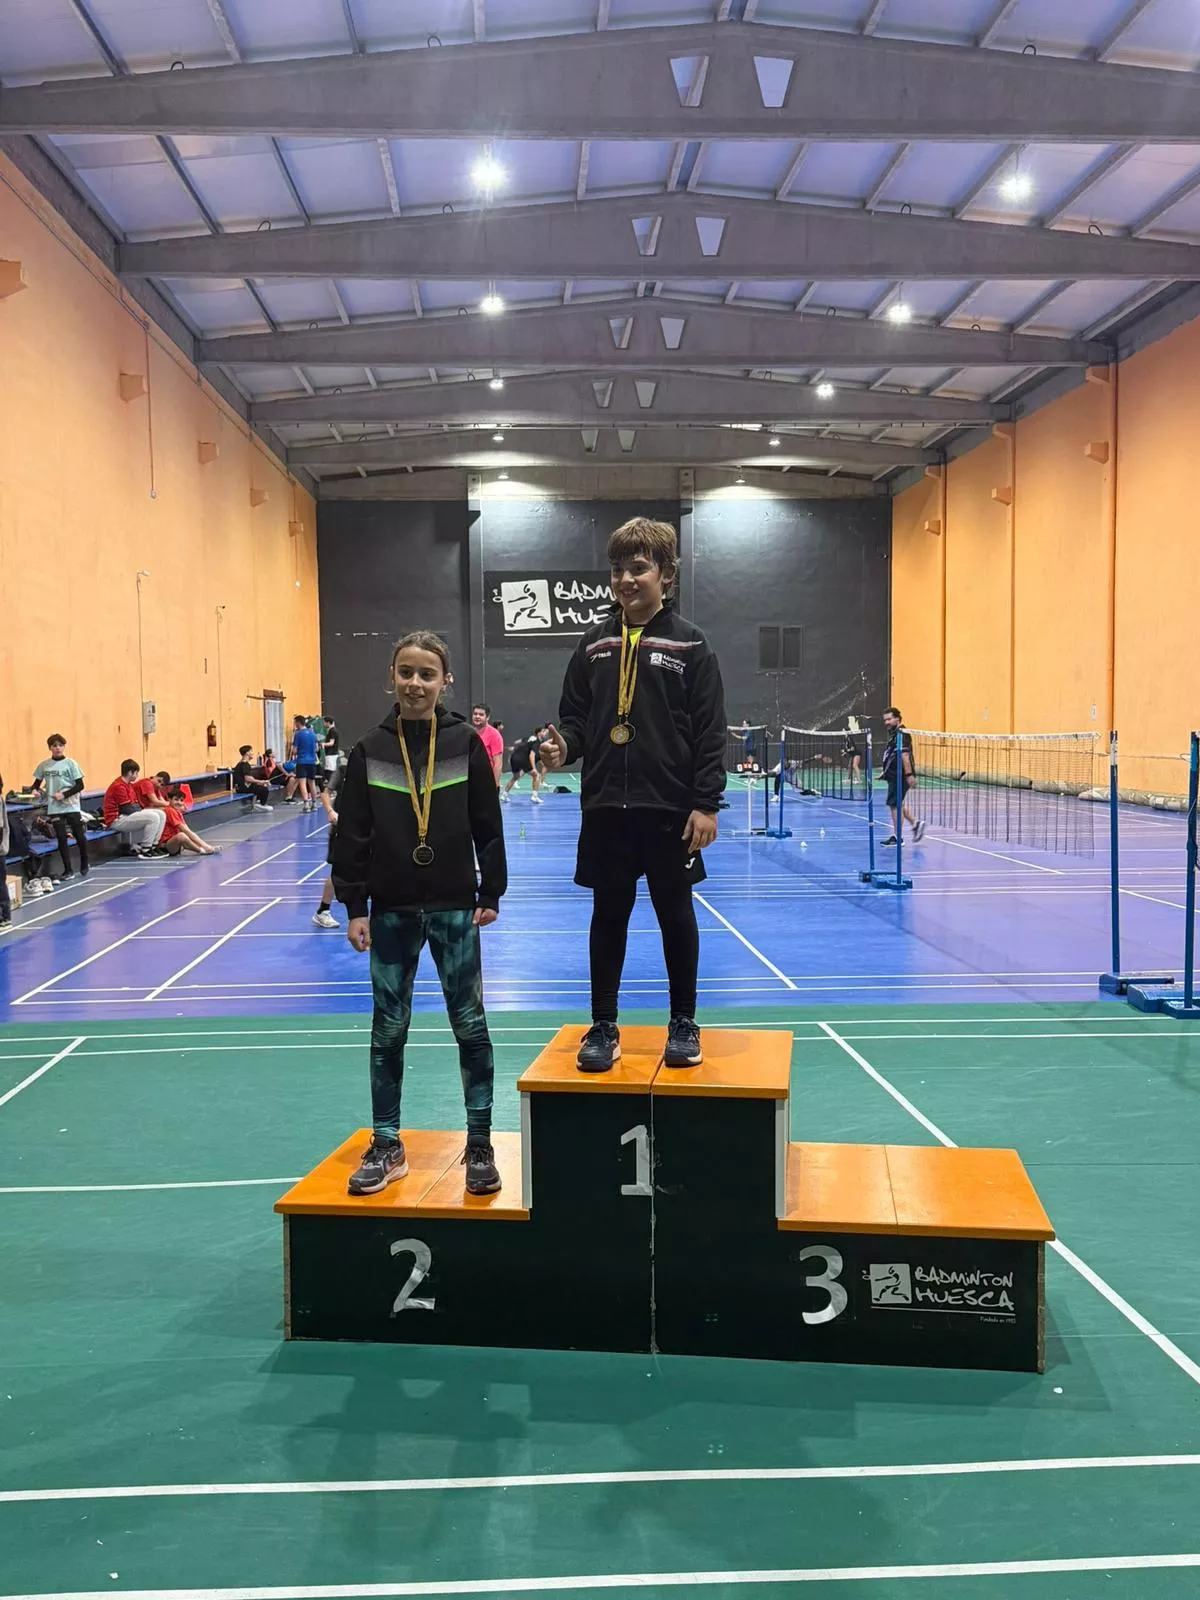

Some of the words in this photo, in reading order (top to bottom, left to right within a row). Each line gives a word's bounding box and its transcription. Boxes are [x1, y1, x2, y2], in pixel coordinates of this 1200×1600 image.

[553, 580, 617, 602] BADM
[555, 604, 612, 624] HUE
[621, 1125, 652, 1195] 1
[390, 1238, 435, 1312] 2
[800, 1245, 847, 1324] 3
[914, 1287, 1015, 1311] HUESCA
